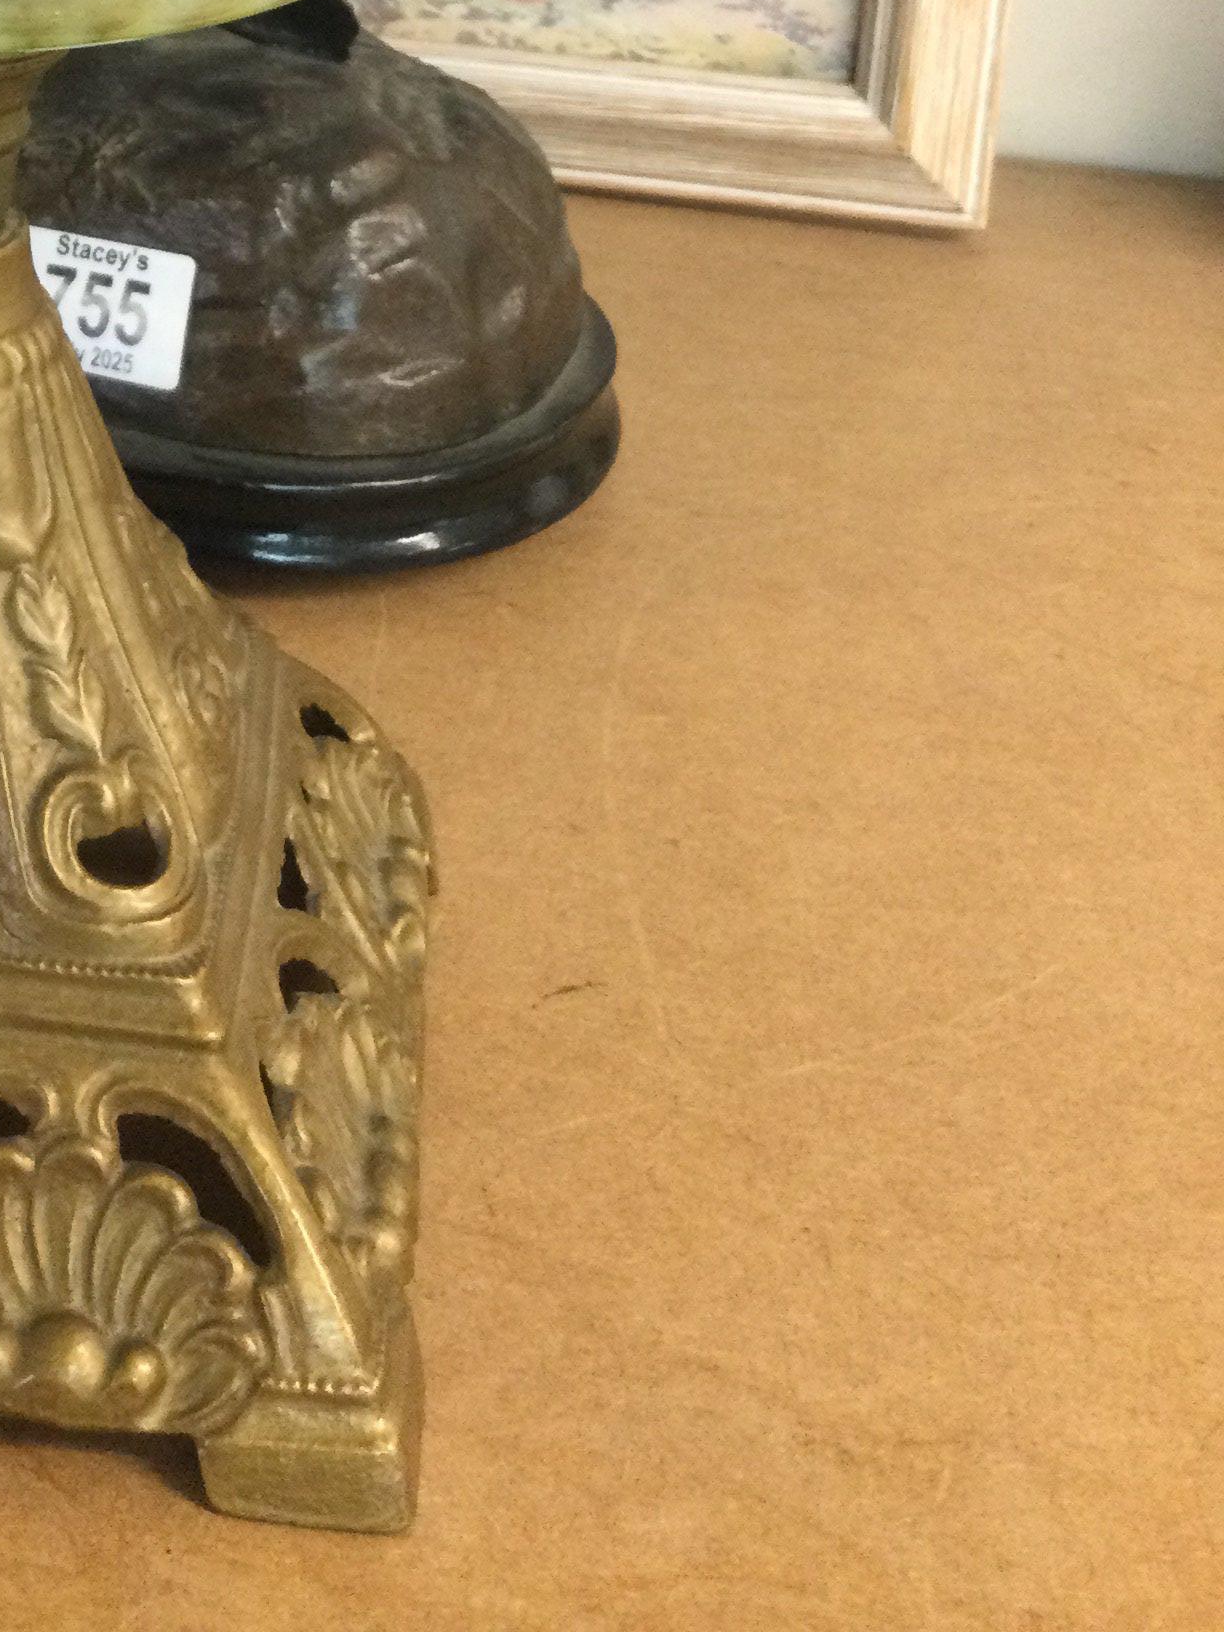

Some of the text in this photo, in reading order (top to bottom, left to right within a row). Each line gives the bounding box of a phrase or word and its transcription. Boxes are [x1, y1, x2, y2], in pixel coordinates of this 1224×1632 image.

[56, 233, 149, 271] Stacey's
[46, 264, 151, 346] 755
[90, 346, 134, 374] 2025
